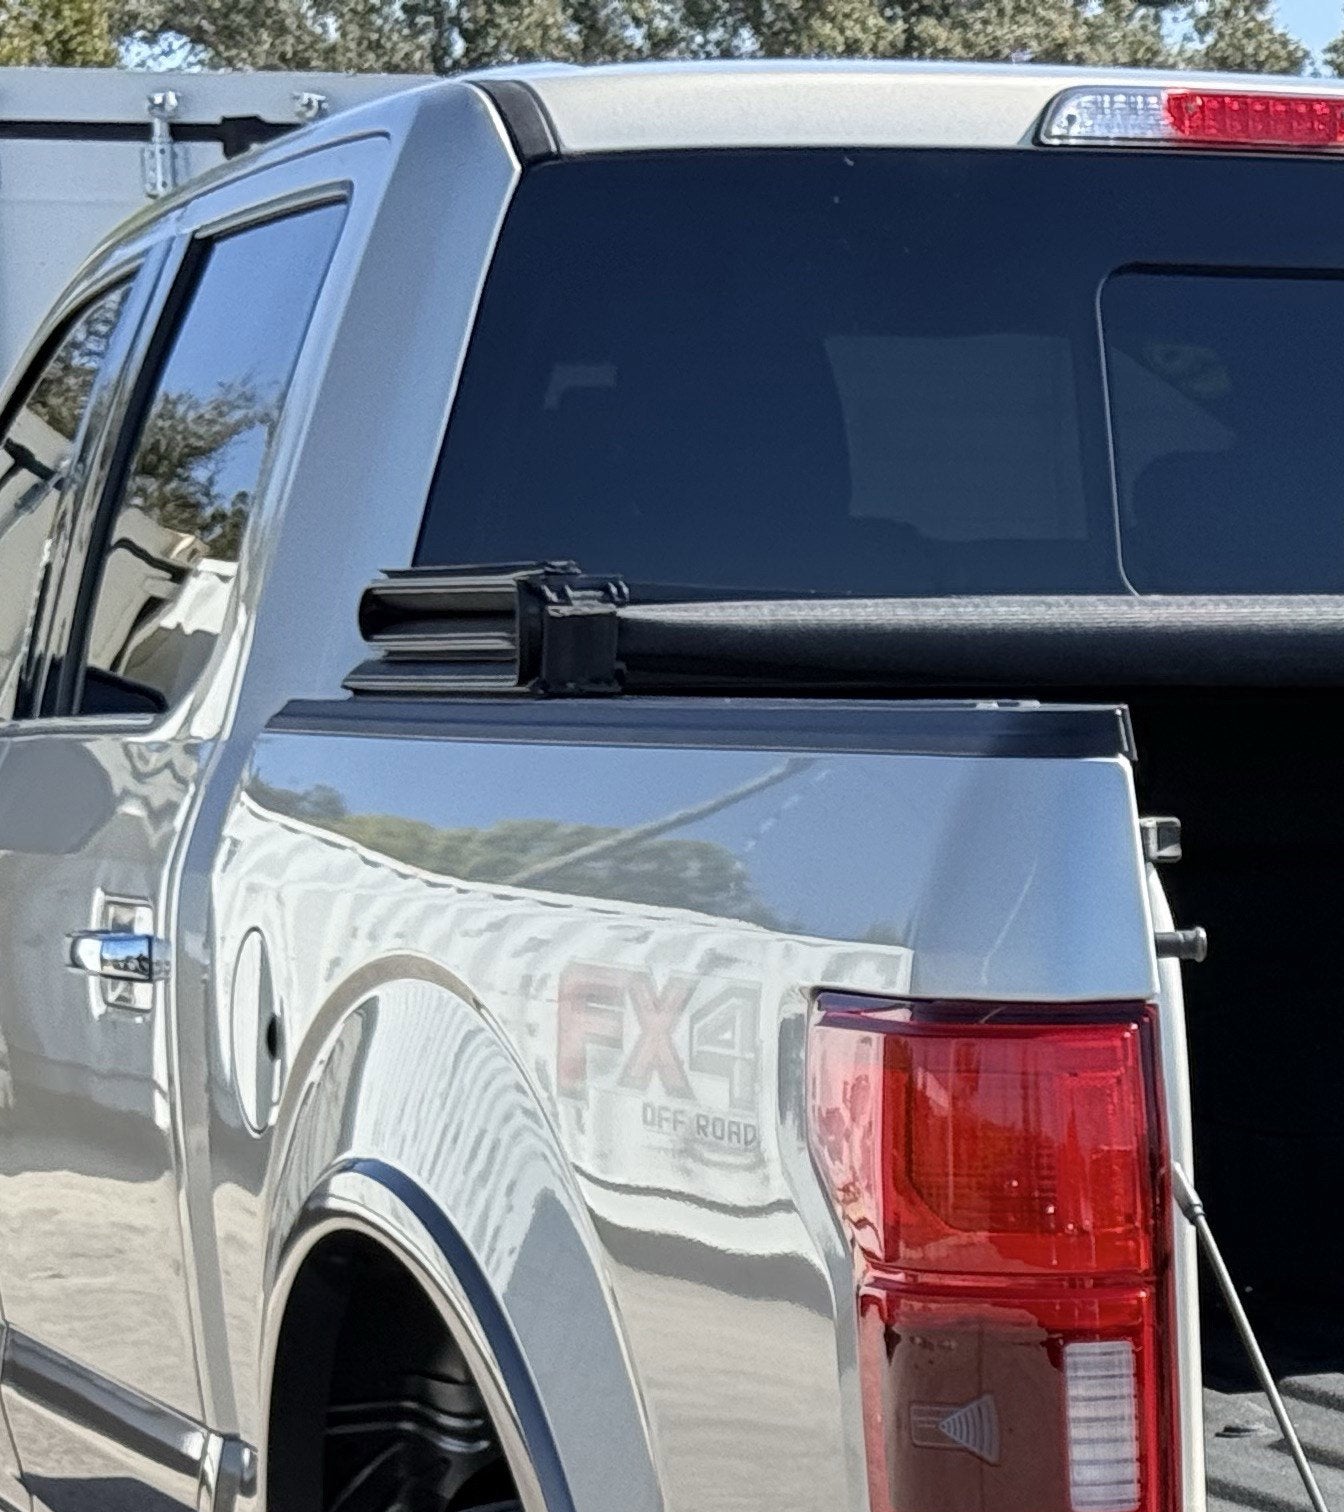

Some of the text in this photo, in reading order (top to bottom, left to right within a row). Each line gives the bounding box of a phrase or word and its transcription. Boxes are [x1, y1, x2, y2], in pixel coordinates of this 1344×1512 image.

[556, 961, 763, 1112] FX4
[641, 1101, 757, 1147] OFF ROAD
